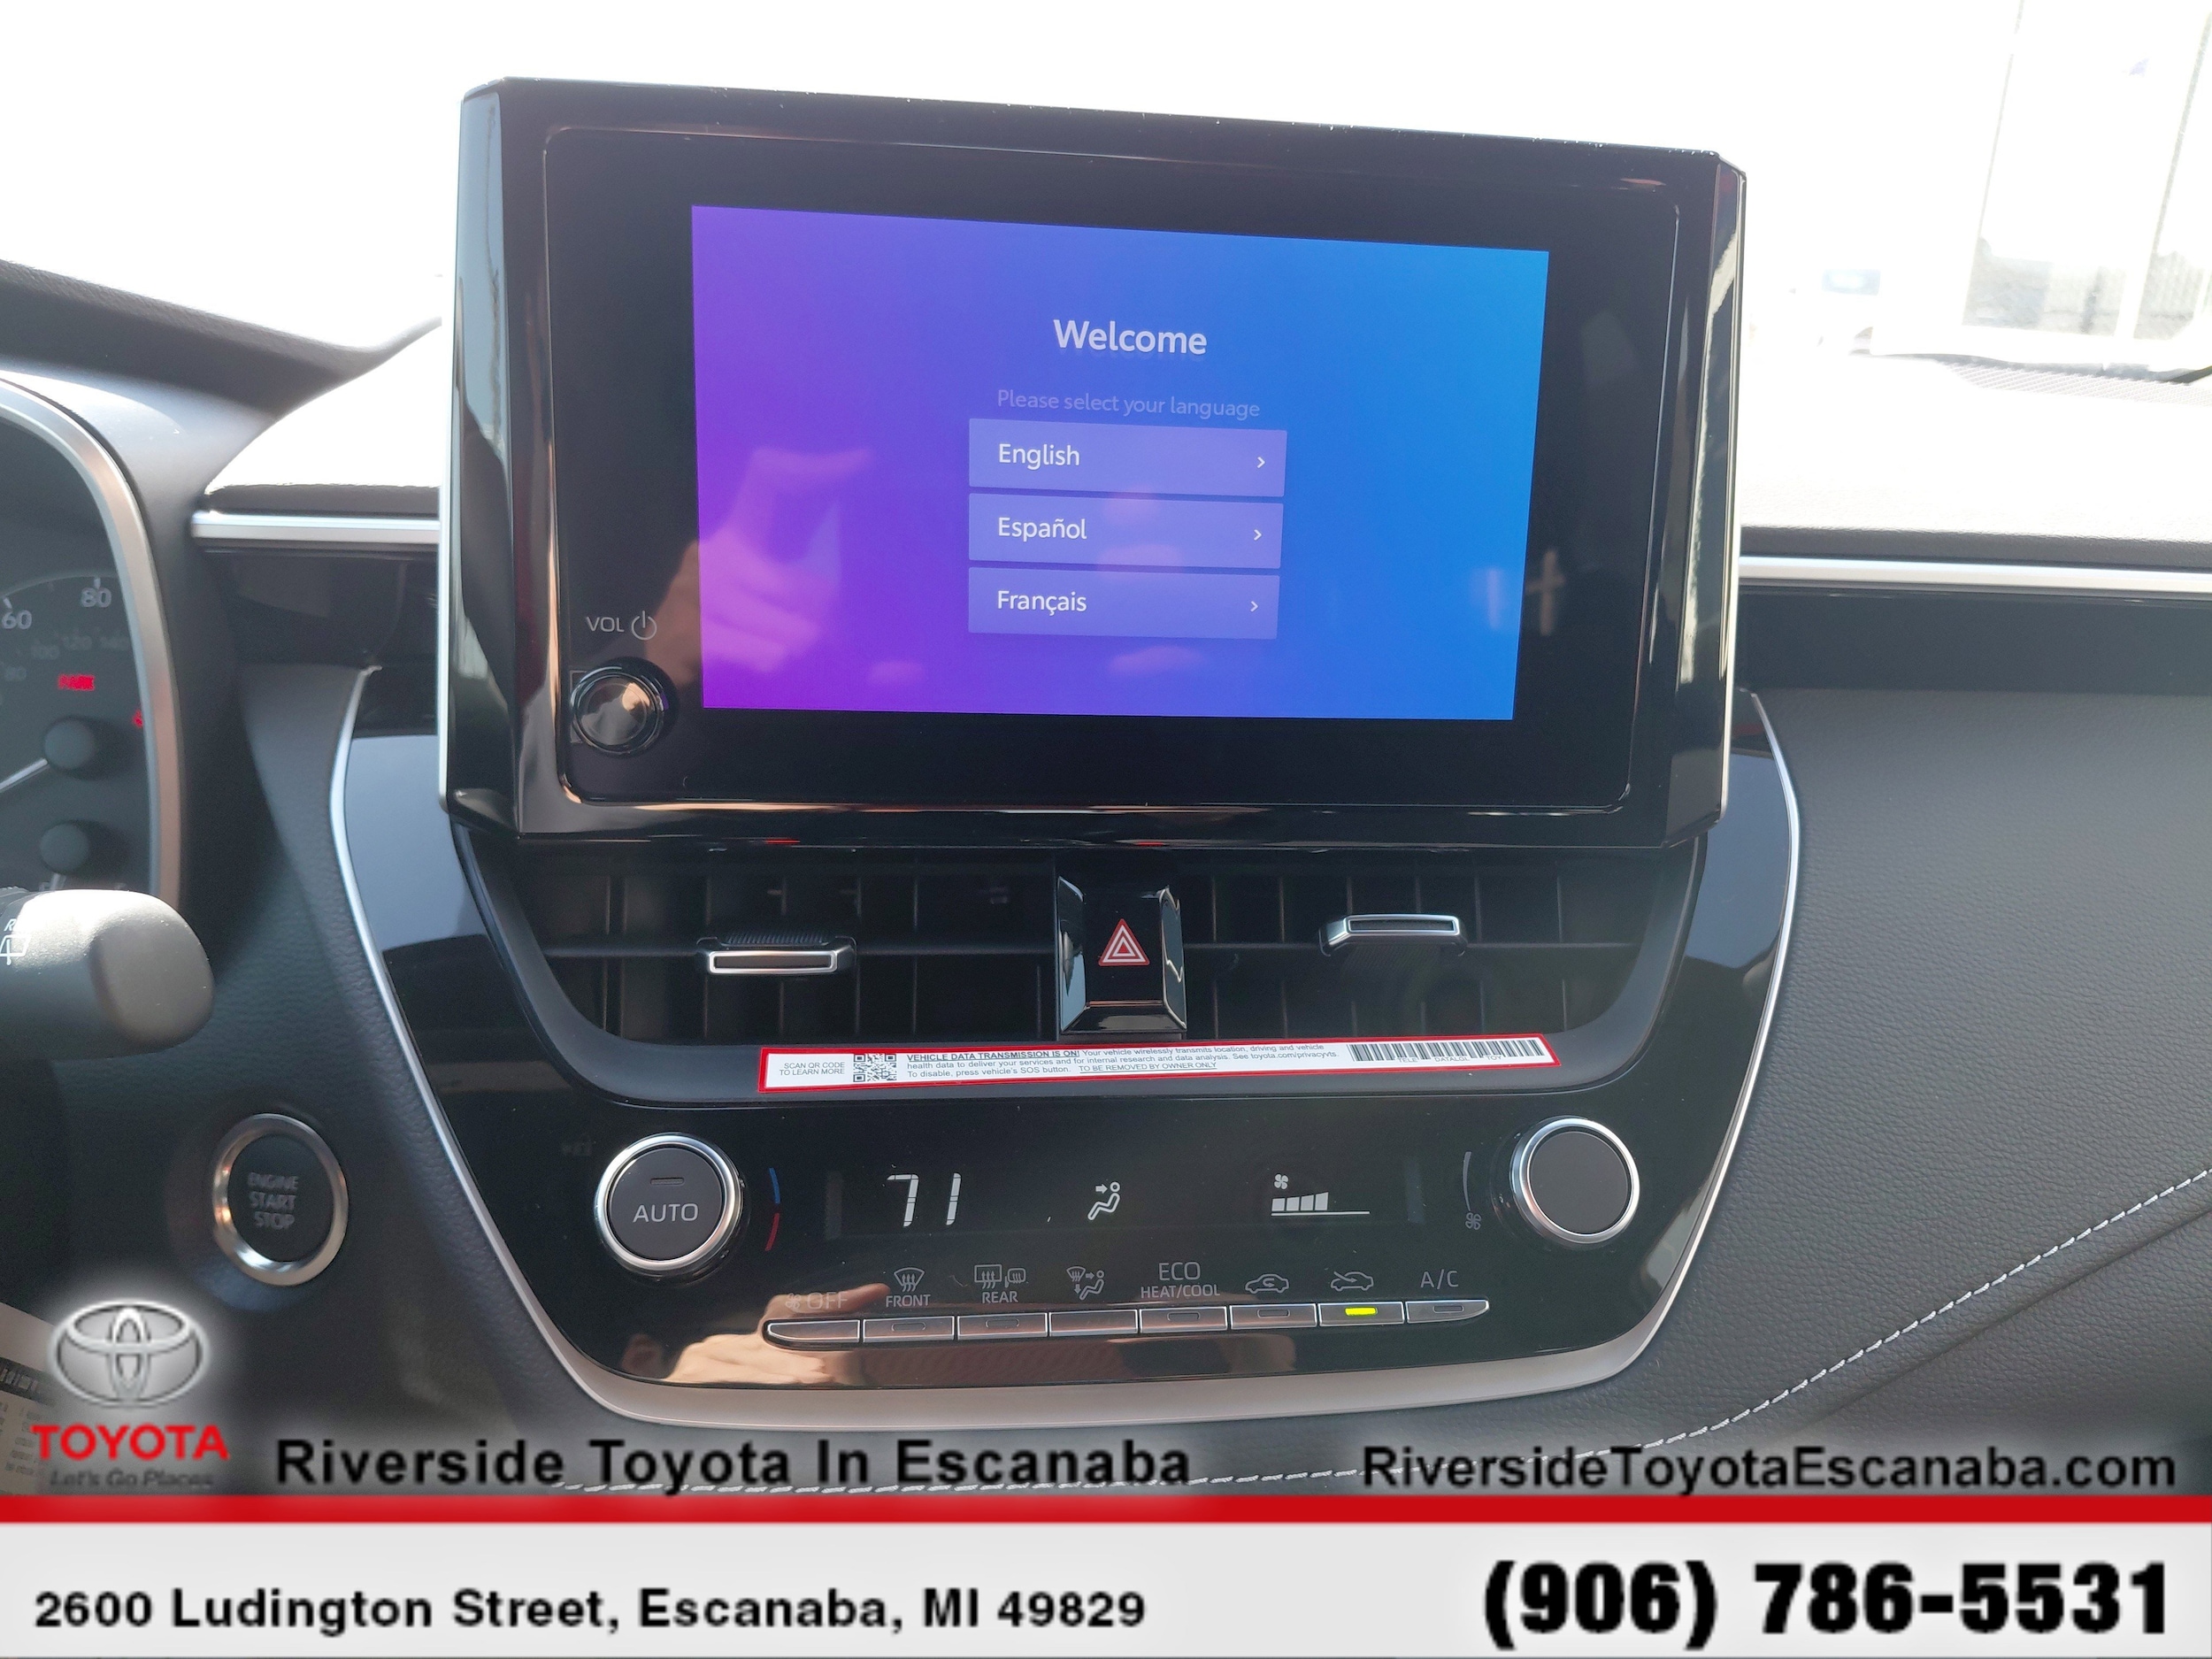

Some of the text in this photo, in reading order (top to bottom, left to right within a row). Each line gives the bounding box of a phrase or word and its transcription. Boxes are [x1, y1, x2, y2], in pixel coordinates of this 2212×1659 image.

[1053, 319, 1207, 355] Welcome
[997, 389, 1261, 421] Please select your language
[998, 443, 1080, 470] English
[998, 517, 1087, 542] Español
[81, 588, 112, 608] 80
[997, 590, 1087, 617] Français
[3, 610, 33, 629] 60
[586, 616, 625, 633] VOL
[979, 1051, 1050, 1060] TRANSMISSION
[249, 1190, 296, 1211] START
[887, 1173, 962, 1227] 71
[253, 1210, 296, 1231] STOP
[633, 1203, 699, 1223] AUTO
[1158, 1261, 1201, 1281] ECO
[1419, 1269, 1459, 1289] A/C
[806, 1291, 849, 1310] OFF
[886, 1294, 931, 1308] FRONT
[981, 1290, 1018, 1303] REAR
[1140, 1284, 1221, 1299] HEAT/COOL
